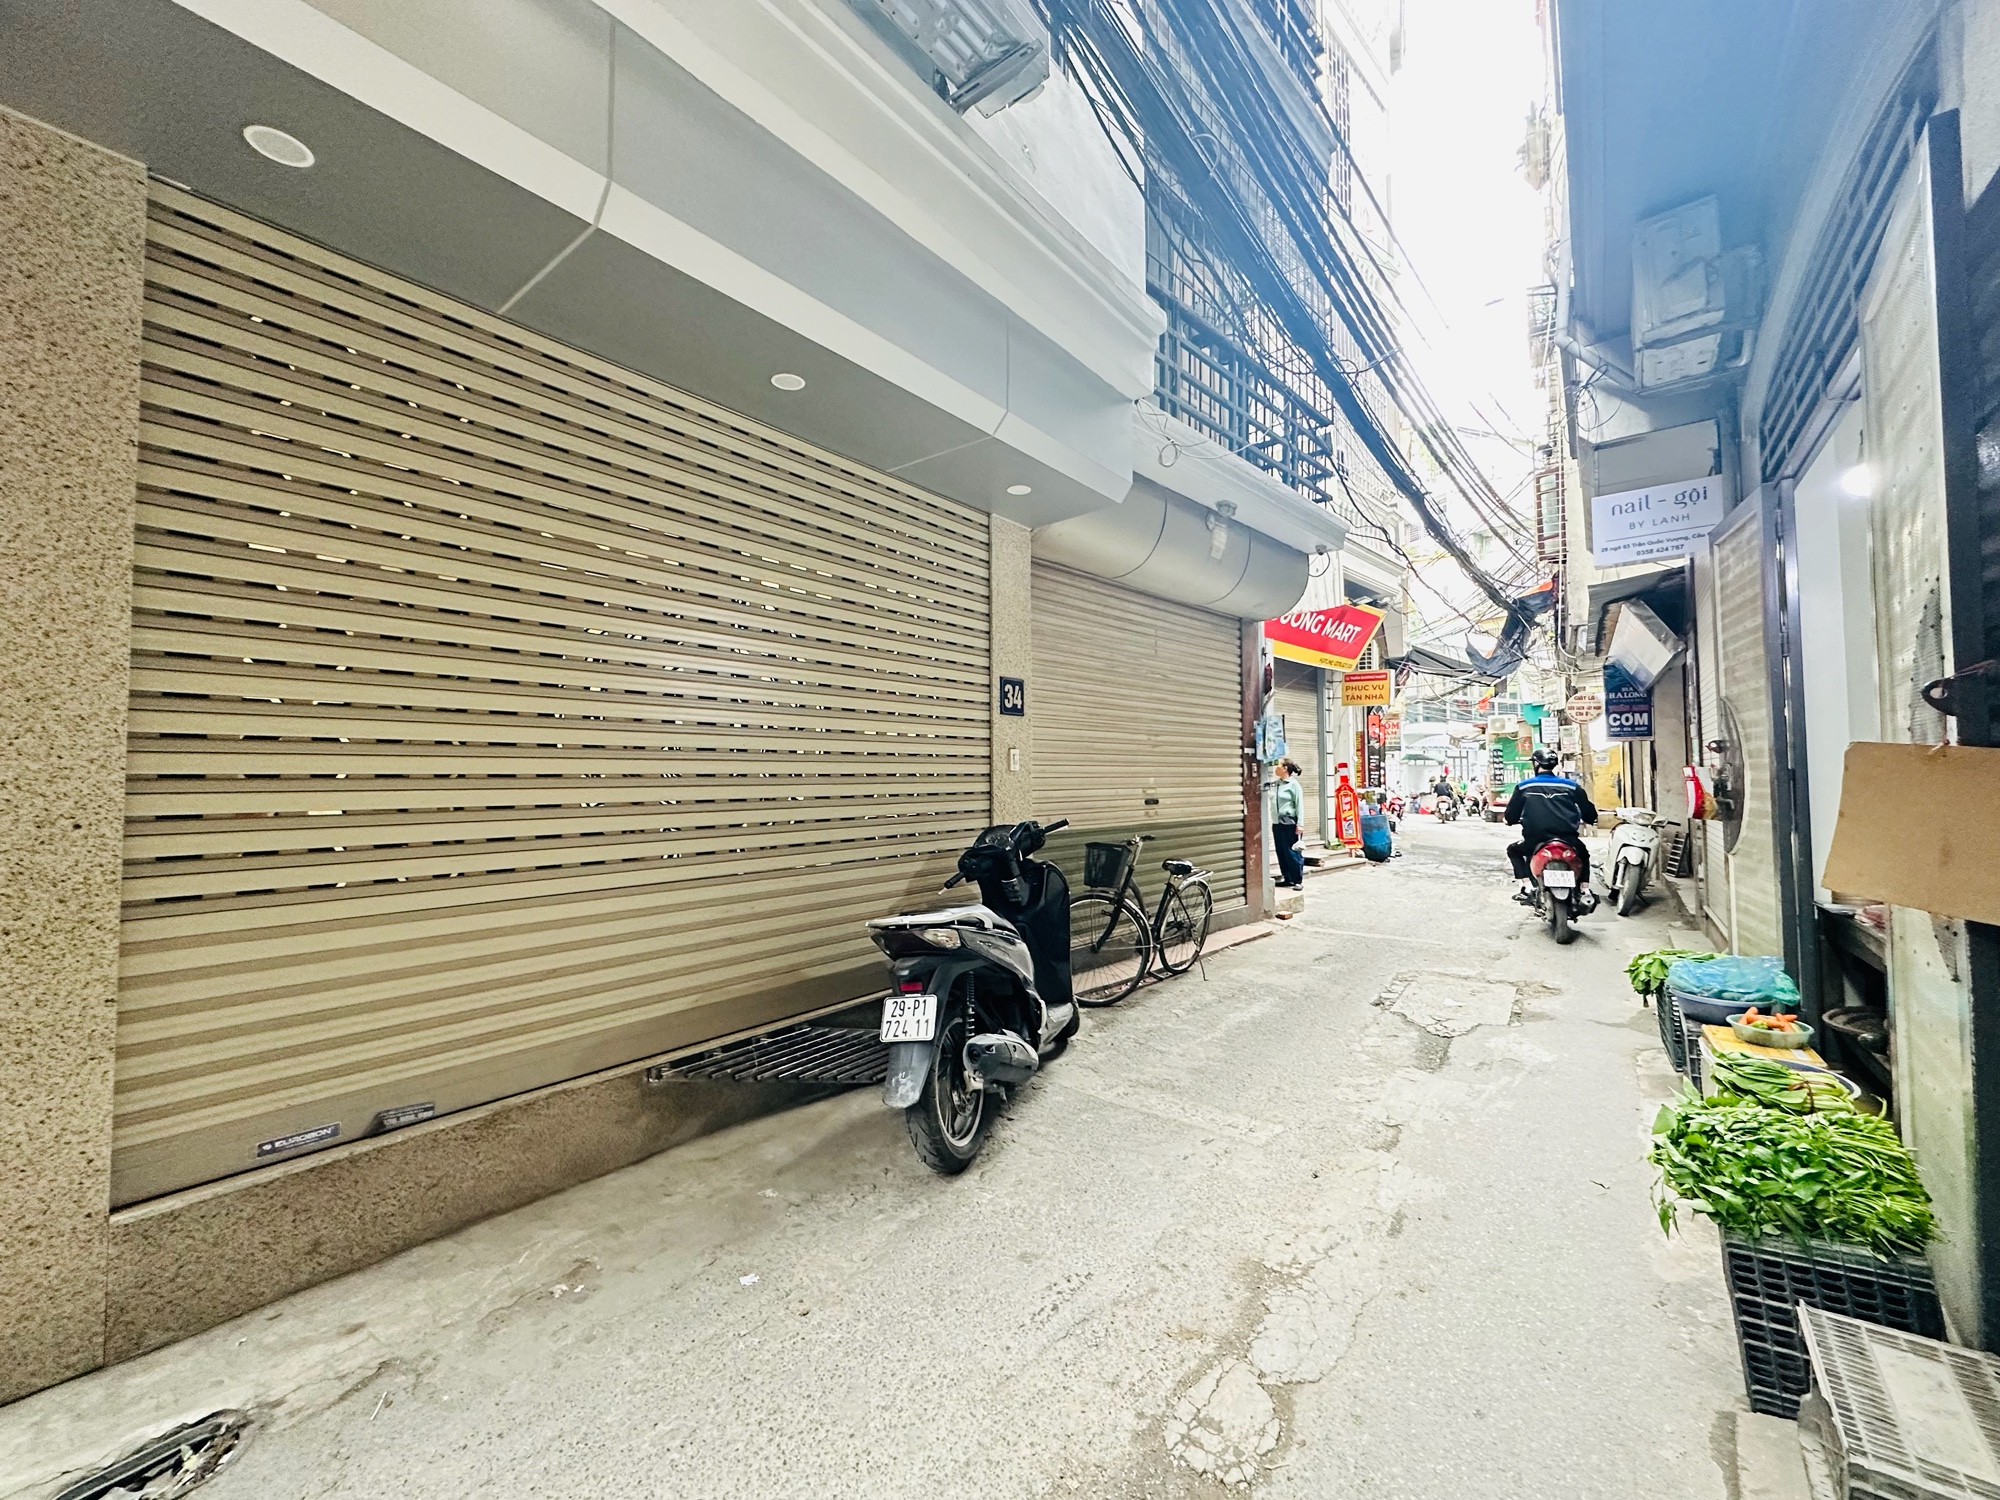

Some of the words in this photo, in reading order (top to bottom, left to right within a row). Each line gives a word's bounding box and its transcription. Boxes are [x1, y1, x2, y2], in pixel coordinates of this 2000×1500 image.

[1612, 494, 1651, 516] nail
[1673, 486, 1708, 509] gội
[1629, 521, 1645, 530] BY
[1652, 513, 1691, 527] LANH
[1321, 617, 1362, 643] MART
[1004, 684, 1022, 709] 34
[1608, 712, 1649, 727] CƠM
[890, 999, 927, 1018] 29-P1
[884, 1018, 930, 1038] 724.11
